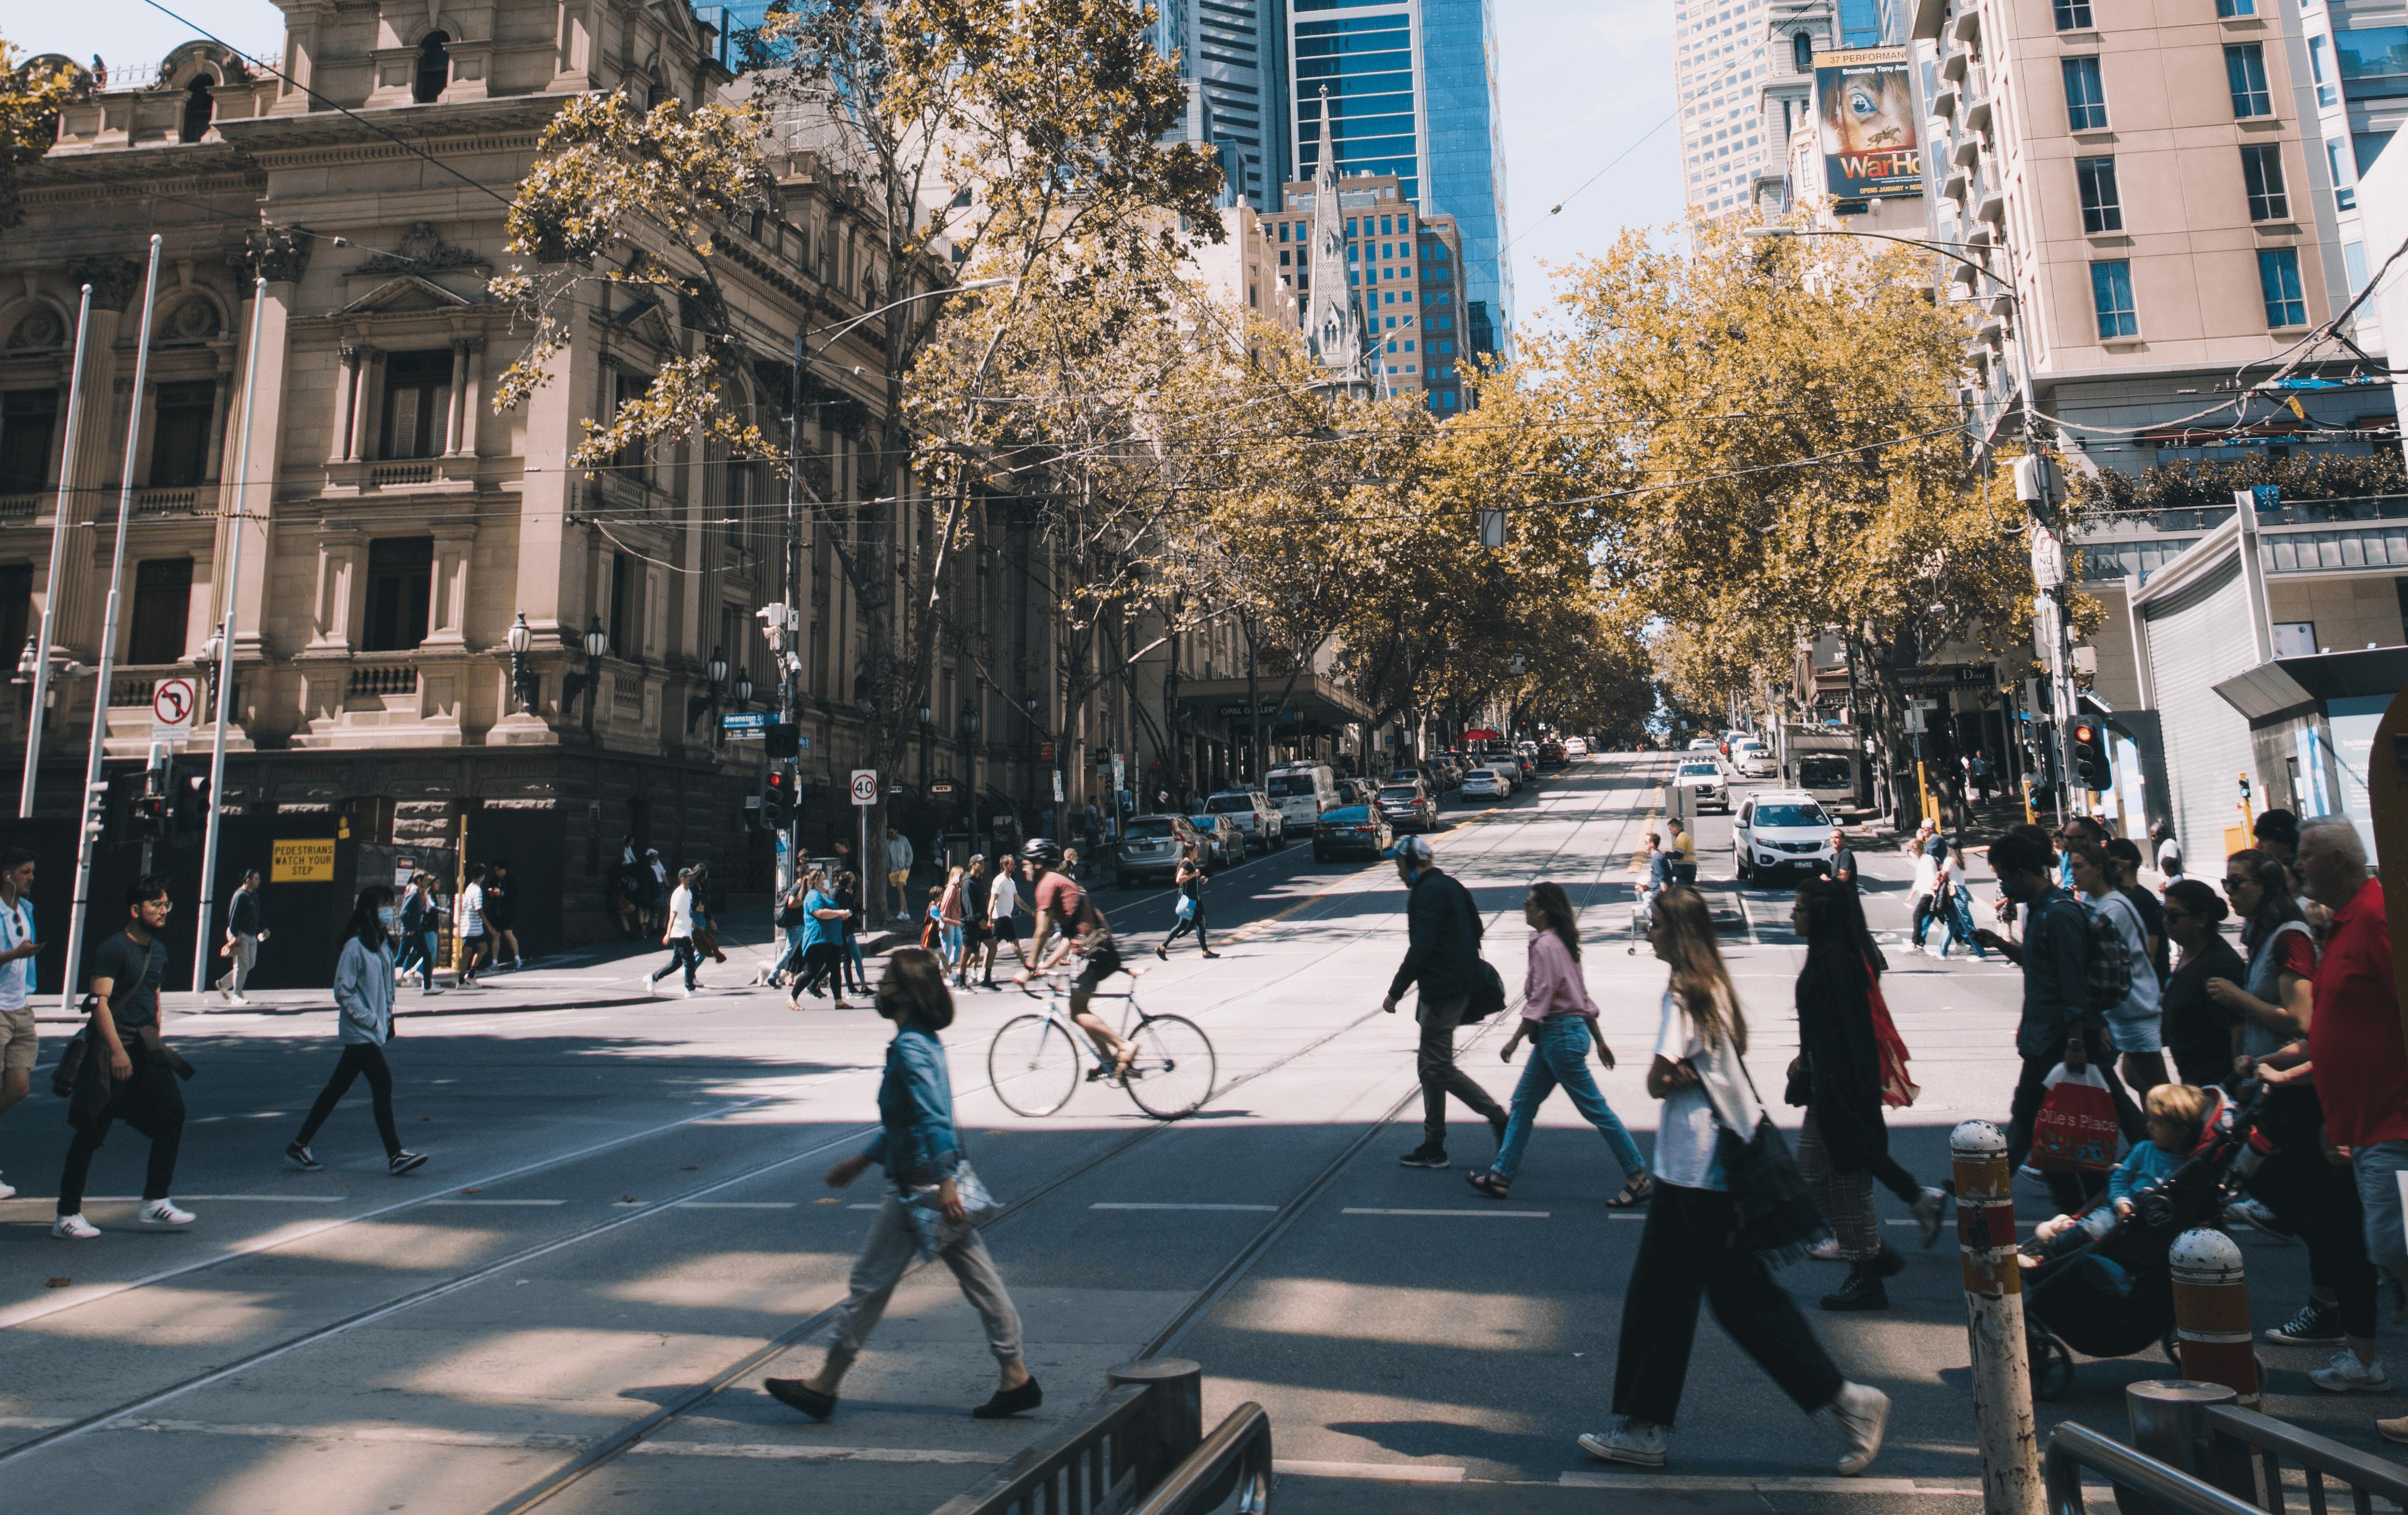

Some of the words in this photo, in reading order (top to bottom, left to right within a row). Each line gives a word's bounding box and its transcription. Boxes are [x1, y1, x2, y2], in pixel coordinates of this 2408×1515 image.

[1842, 67, 1875, 75] Broadway
[2040, 556, 2053, 564] NO
[1963, 669, 1986, 680] Dior
[1244, 706, 1277, 714] GLLERY
[855, 781, 873, 794] 40
[275, 846, 333, 855] PEDESTRIANS
[275, 856, 305, 865] WATCH
[309, 856, 332, 865] YOUR
[292, 866, 313, 875] STEP
[2080, 1114, 2118, 1132] Place
